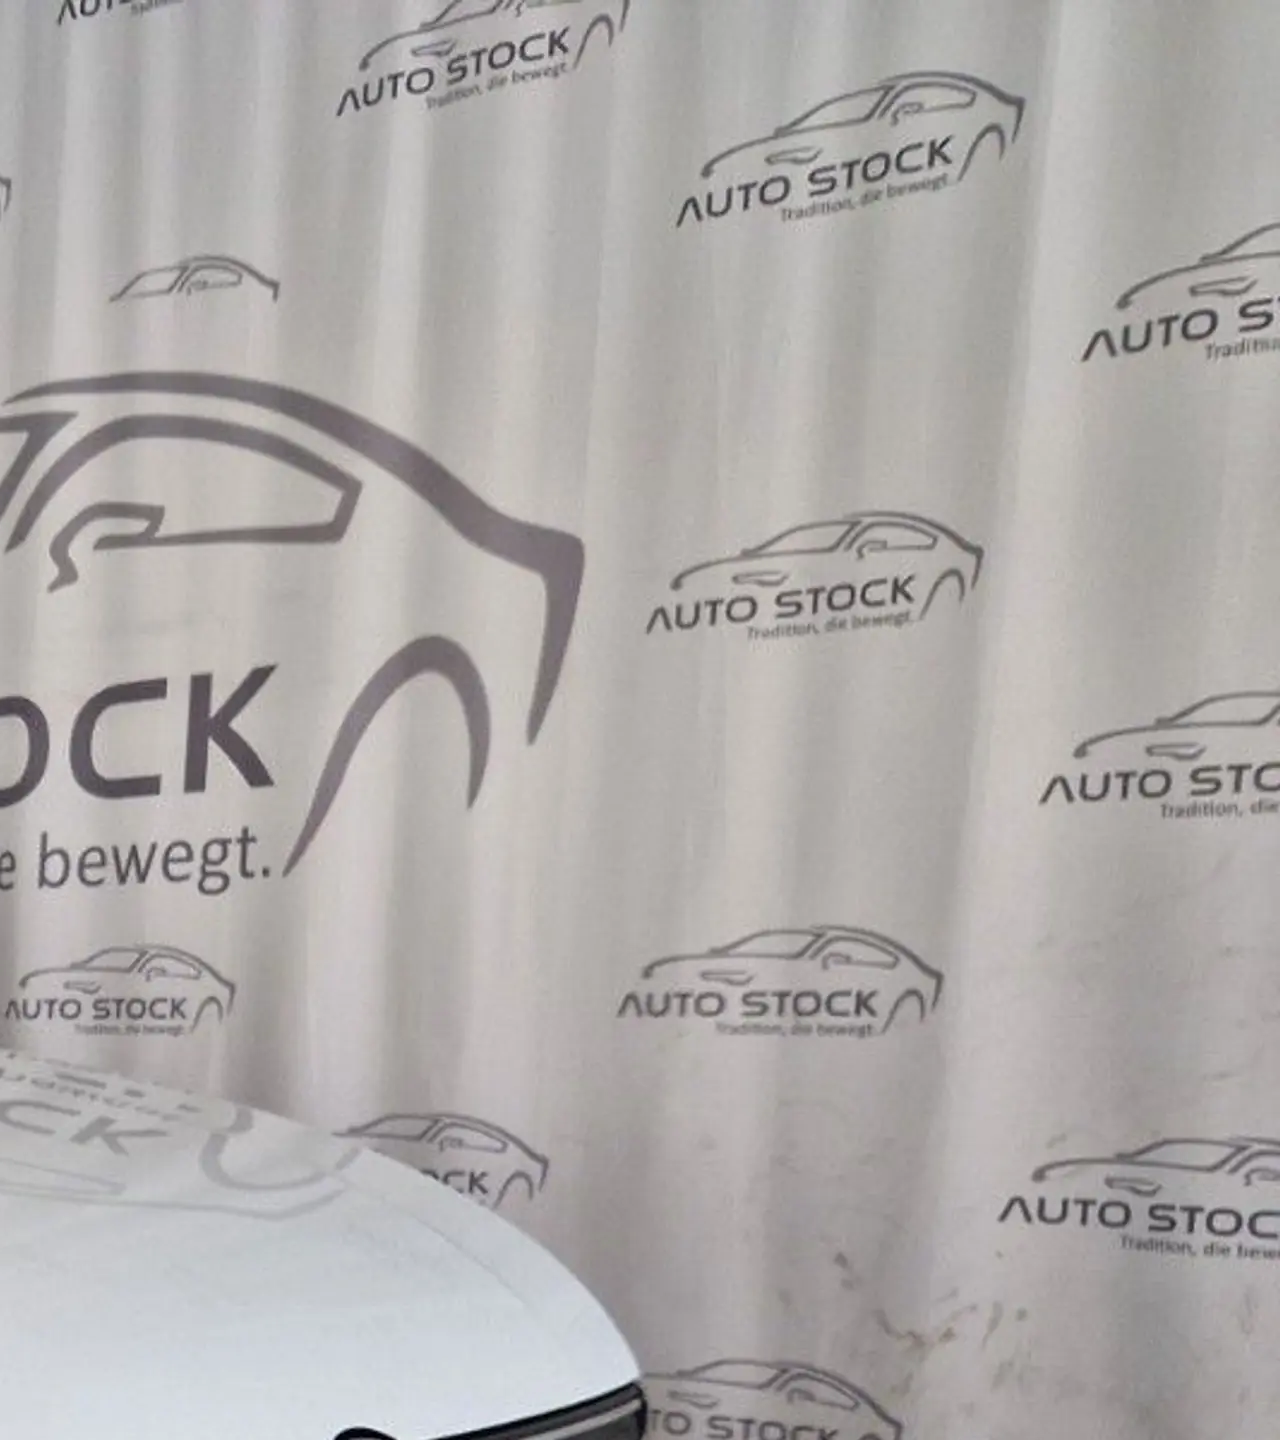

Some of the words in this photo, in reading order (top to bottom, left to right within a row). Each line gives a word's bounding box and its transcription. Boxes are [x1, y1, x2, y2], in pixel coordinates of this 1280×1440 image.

[337, 67, 434, 116] AUTO
[447, 26, 570, 86] STOCK
[676, 175, 790, 228] AUTO
[807, 134, 953, 197] STOCK
[1080, 308, 1218, 363] AUTO
[646, 596, 758, 635] AUTO
[775, 575, 915, 620] STOCK
[824, 614, 846, 632] die
[1038, 769, 1172, 806] AUTO
[38, 825, 272, 895] bewegt.
[5, 998, 82, 1020] AUTO
[92, 996, 188, 1020] STOCK
[616, 991, 727, 1018] AUTO
[740, 988, 878, 1018] STOCK
[998, 1195, 1132, 1229] AUTO
[1203, 1241, 1232, 1257] die
